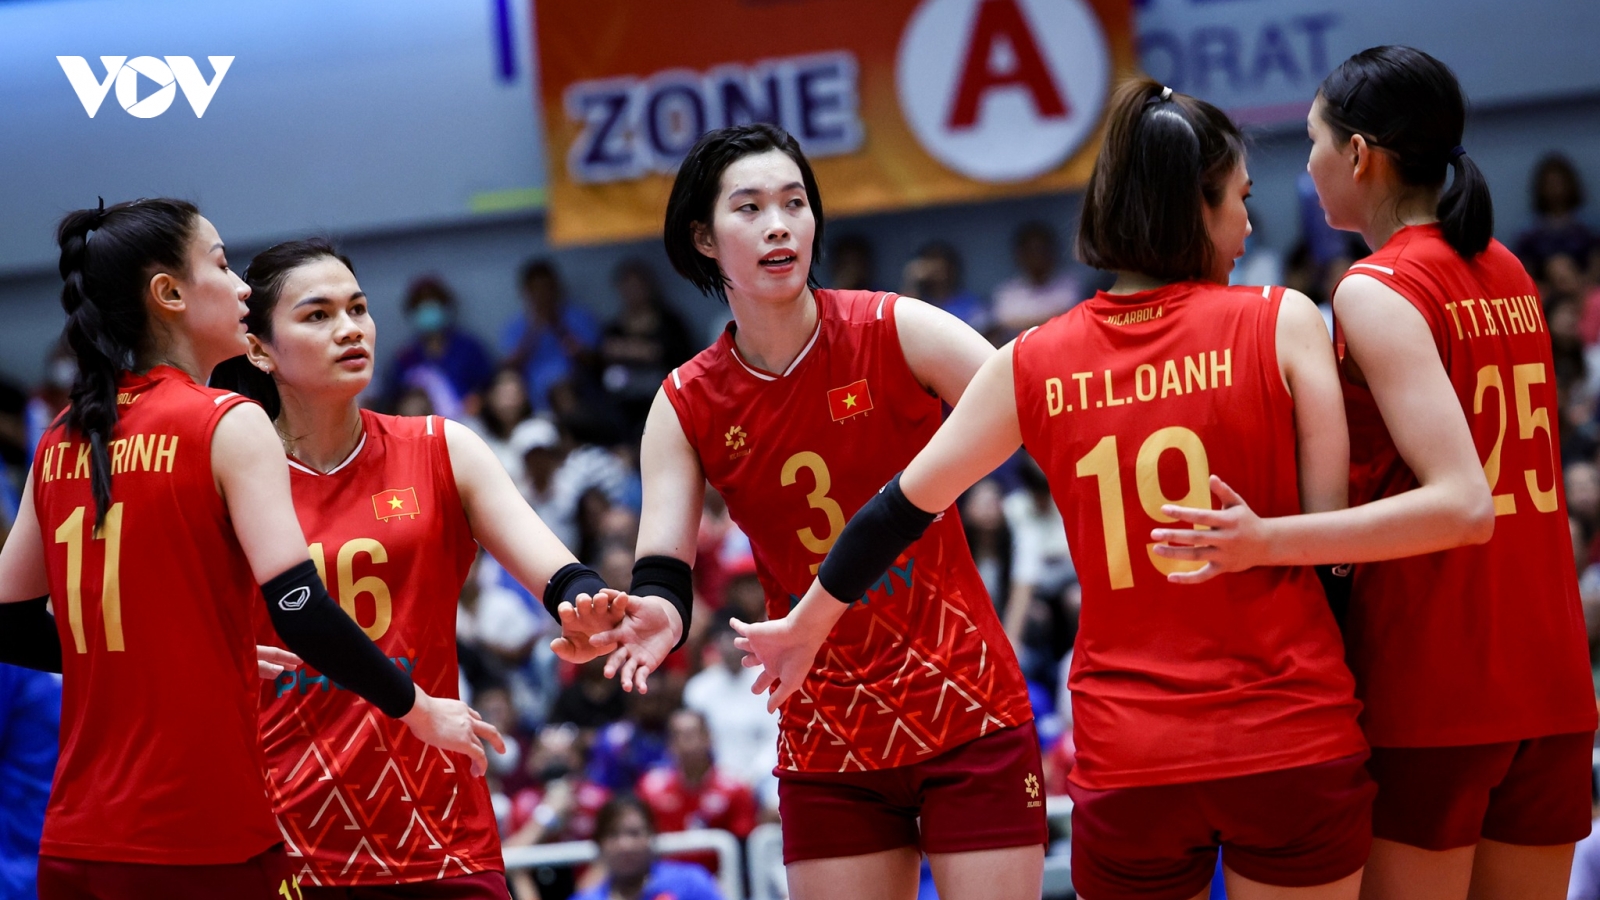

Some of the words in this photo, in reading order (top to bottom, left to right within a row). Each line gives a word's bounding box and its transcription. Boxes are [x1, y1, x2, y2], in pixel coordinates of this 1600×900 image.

[568, 58, 856, 174] ZONE
[945, 0, 1071, 131] A
[1045, 348, 1232, 417] Đ.T.L.OANH
[1473, 362, 1559, 517] 25
[780, 450, 846, 555] 3
[1075, 425, 1213, 591] 19
[55, 501, 125, 654] 11
